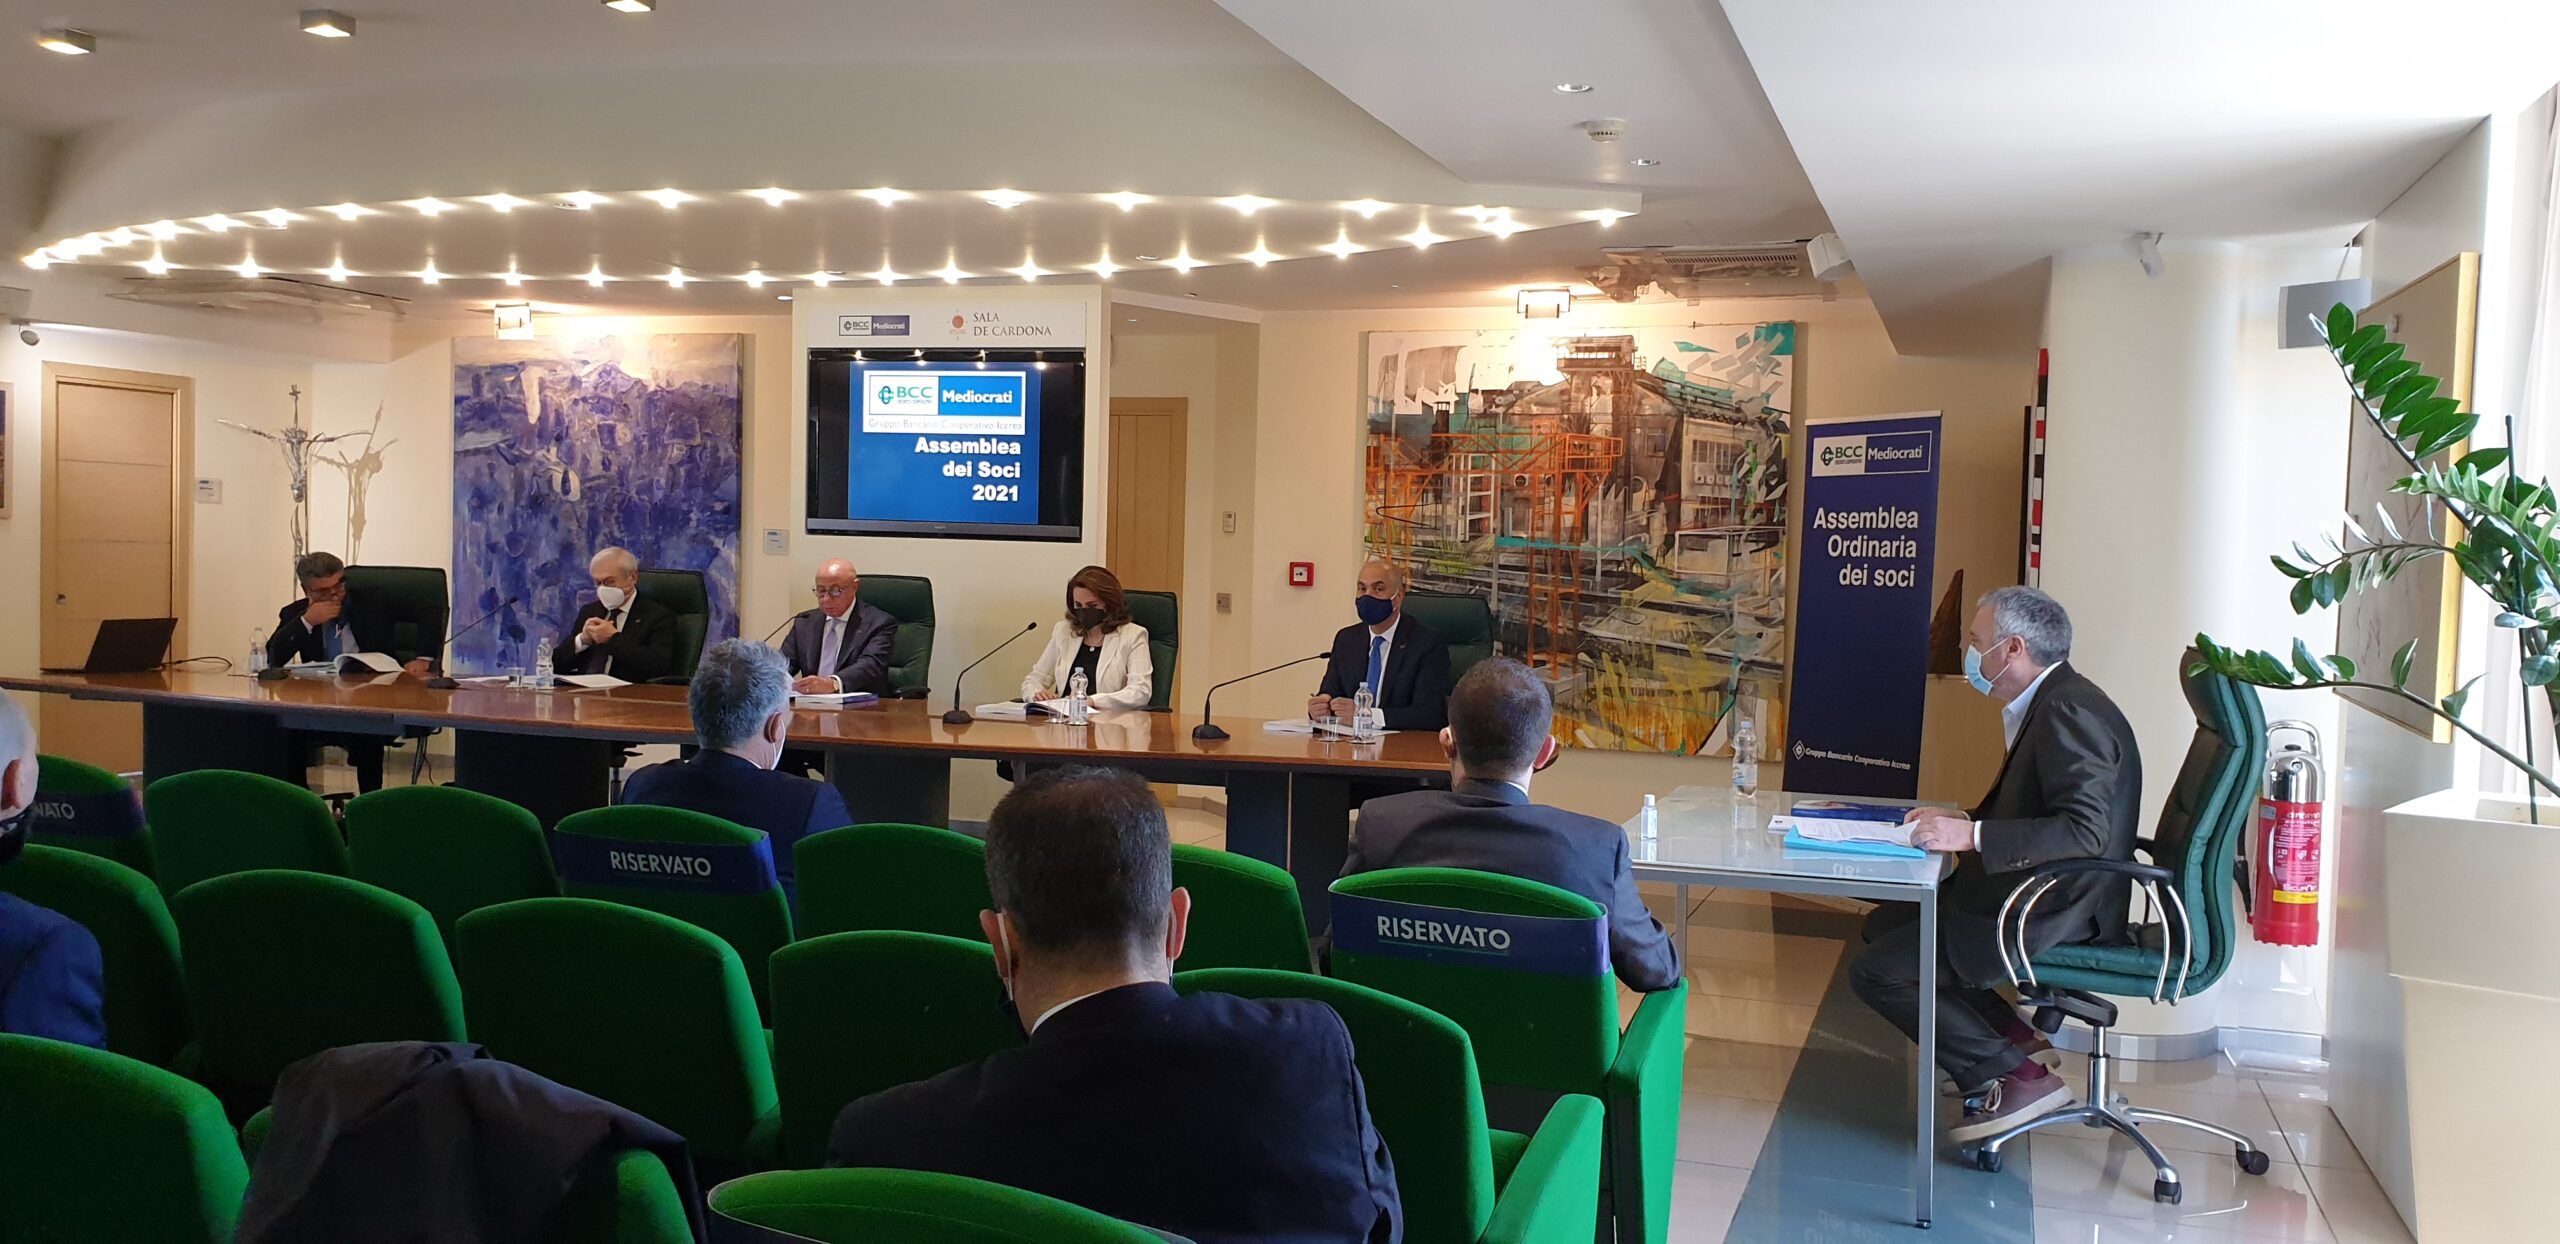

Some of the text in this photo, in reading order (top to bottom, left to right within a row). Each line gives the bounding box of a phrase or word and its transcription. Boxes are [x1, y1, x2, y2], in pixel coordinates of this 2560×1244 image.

[973, 312, 1000, 322] SALA
[973, 326, 1052, 336] DE CARDONA
[896, 386, 933, 398] BCC
[942, 389, 1013, 404] Mediocrati
[914, 436, 1021, 455] Assemblea
[1835, 446, 1863, 459] BCC
[1867, 445, 1923, 460] Mediocrati
[942, 460, 1021, 478] dei Soci
[972, 484, 1018, 501] 2021
[1812, 506, 1919, 529] Assemblea
[1827, 534, 1917, 558] Ordinaria
[1839, 563, 1915, 587] dei soci
[1805, 747, 1827, 758] Gruppo
[609, 850, 712, 877] RISERVATO
[1377, 915, 1511, 950] RISERVATO
